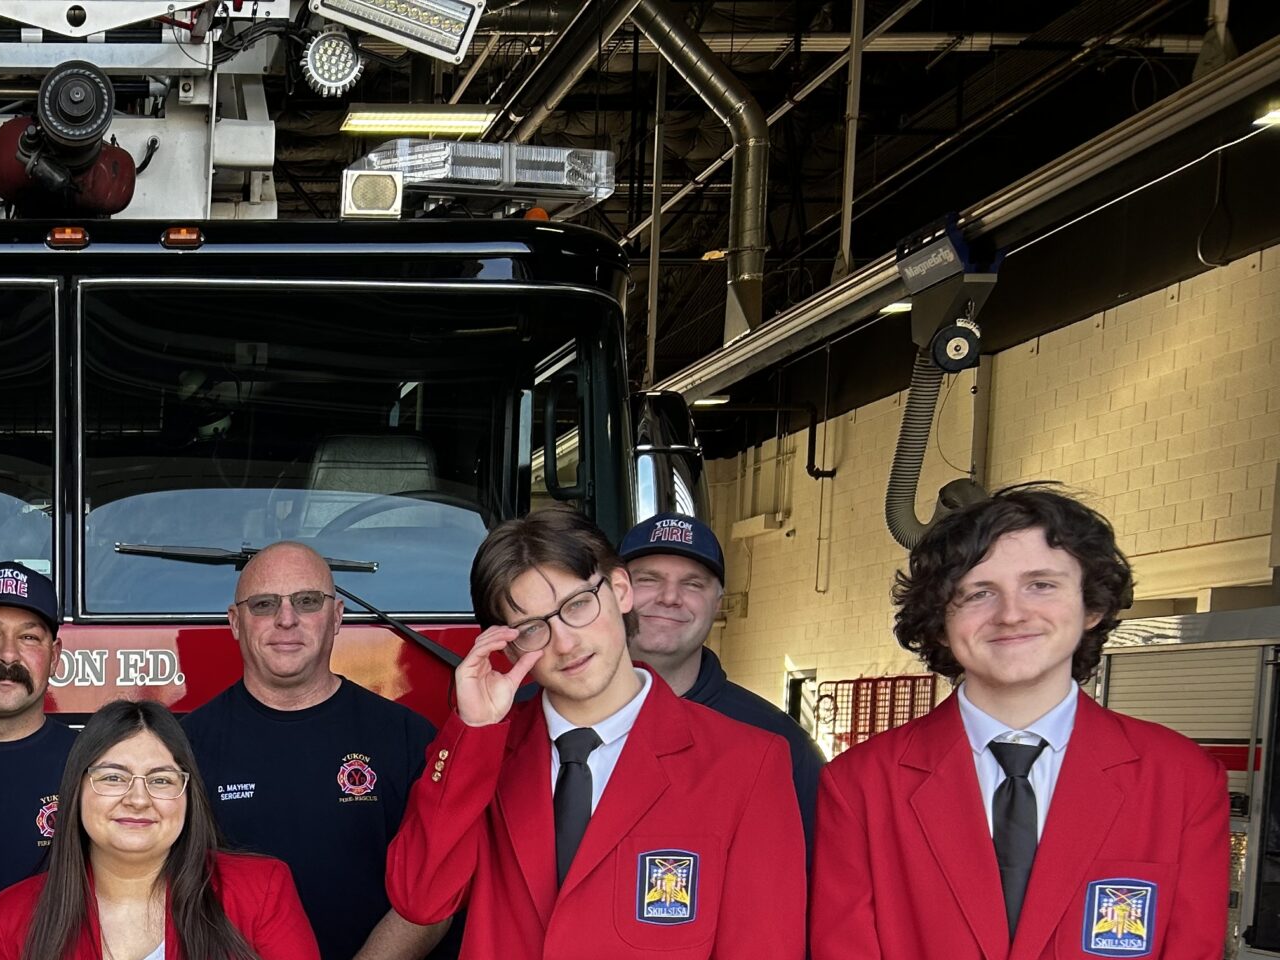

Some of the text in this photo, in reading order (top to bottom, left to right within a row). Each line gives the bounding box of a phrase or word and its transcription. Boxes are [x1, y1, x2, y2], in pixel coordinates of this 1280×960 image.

[655, 518, 693, 530] YUKON
[650, 527, 693, 545] FIRE
[116, 649, 185, 686] F.D.
[341, 753, 371, 763] YUKON
[217, 783, 256, 793] D. MAYHEW
[220, 791, 255, 801] SERGEANT
